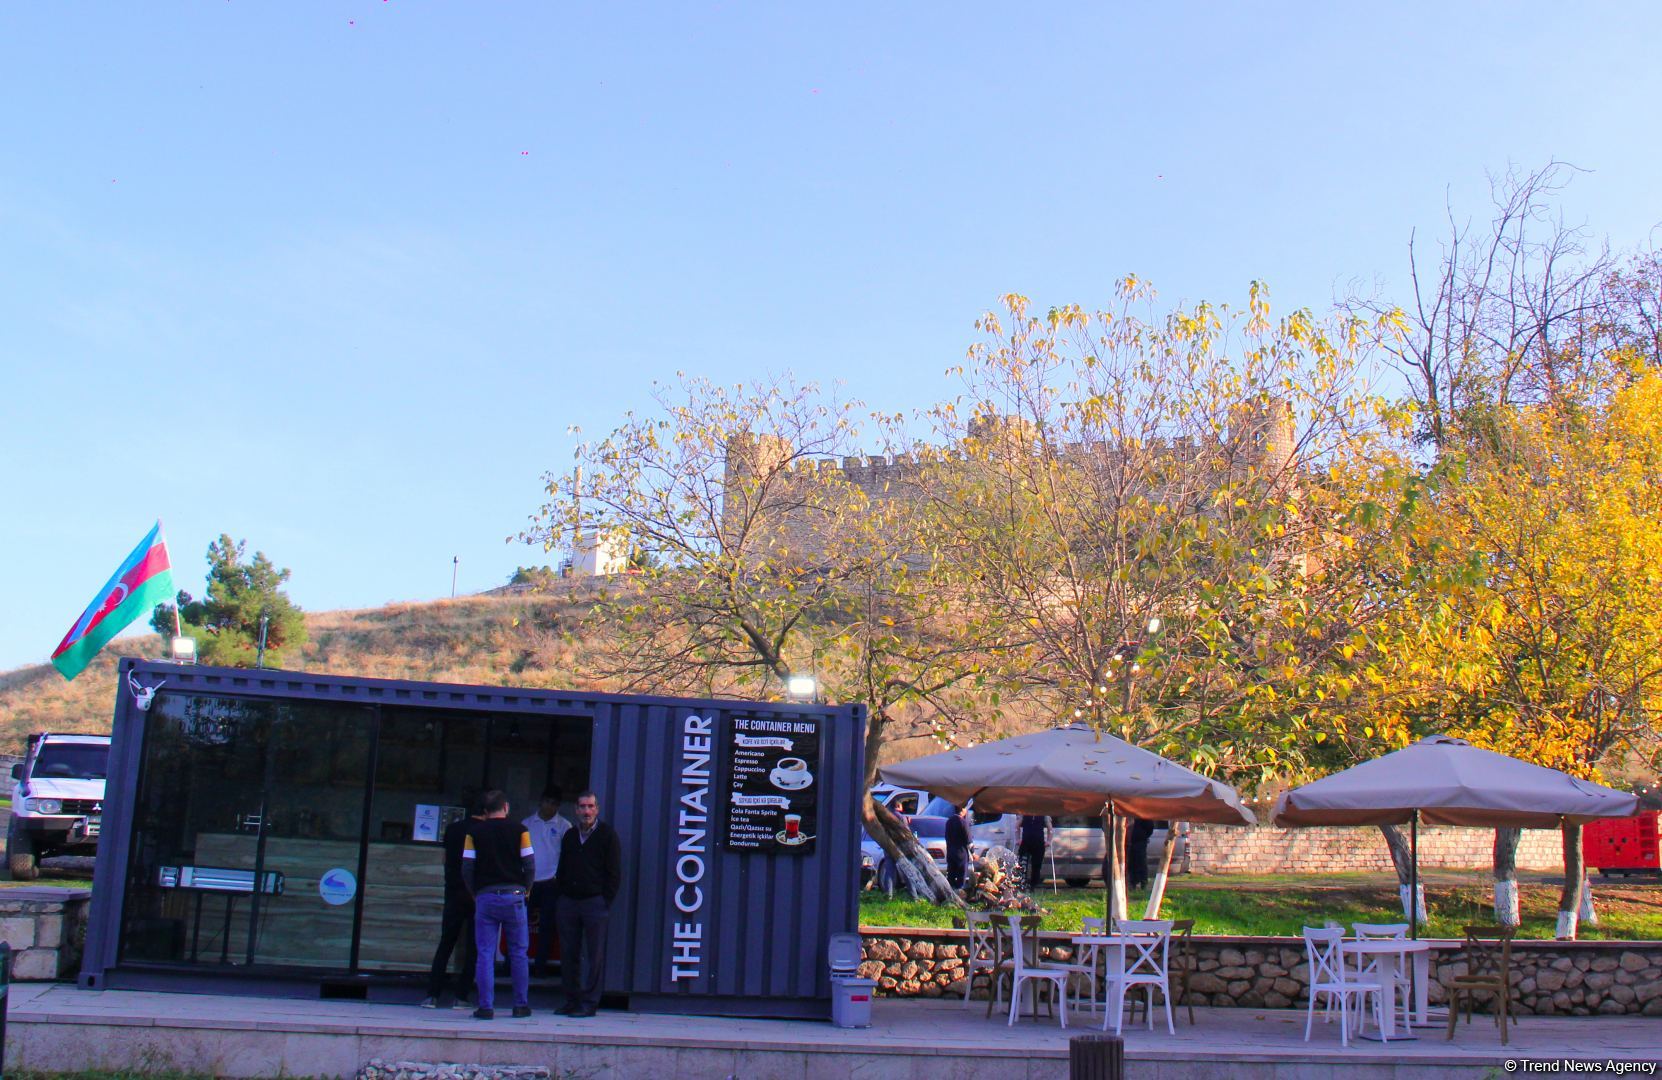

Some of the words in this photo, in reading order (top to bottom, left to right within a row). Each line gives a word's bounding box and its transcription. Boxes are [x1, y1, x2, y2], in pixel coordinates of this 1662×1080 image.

[735, 719, 749, 730] THE
[750, 720, 792, 732] CONTAINER
[793, 722, 816, 733] MENU
[674, 715, 712, 913] CONTAINER
[760, 809, 778, 817] Sprite
[672, 922, 702, 982] THE
